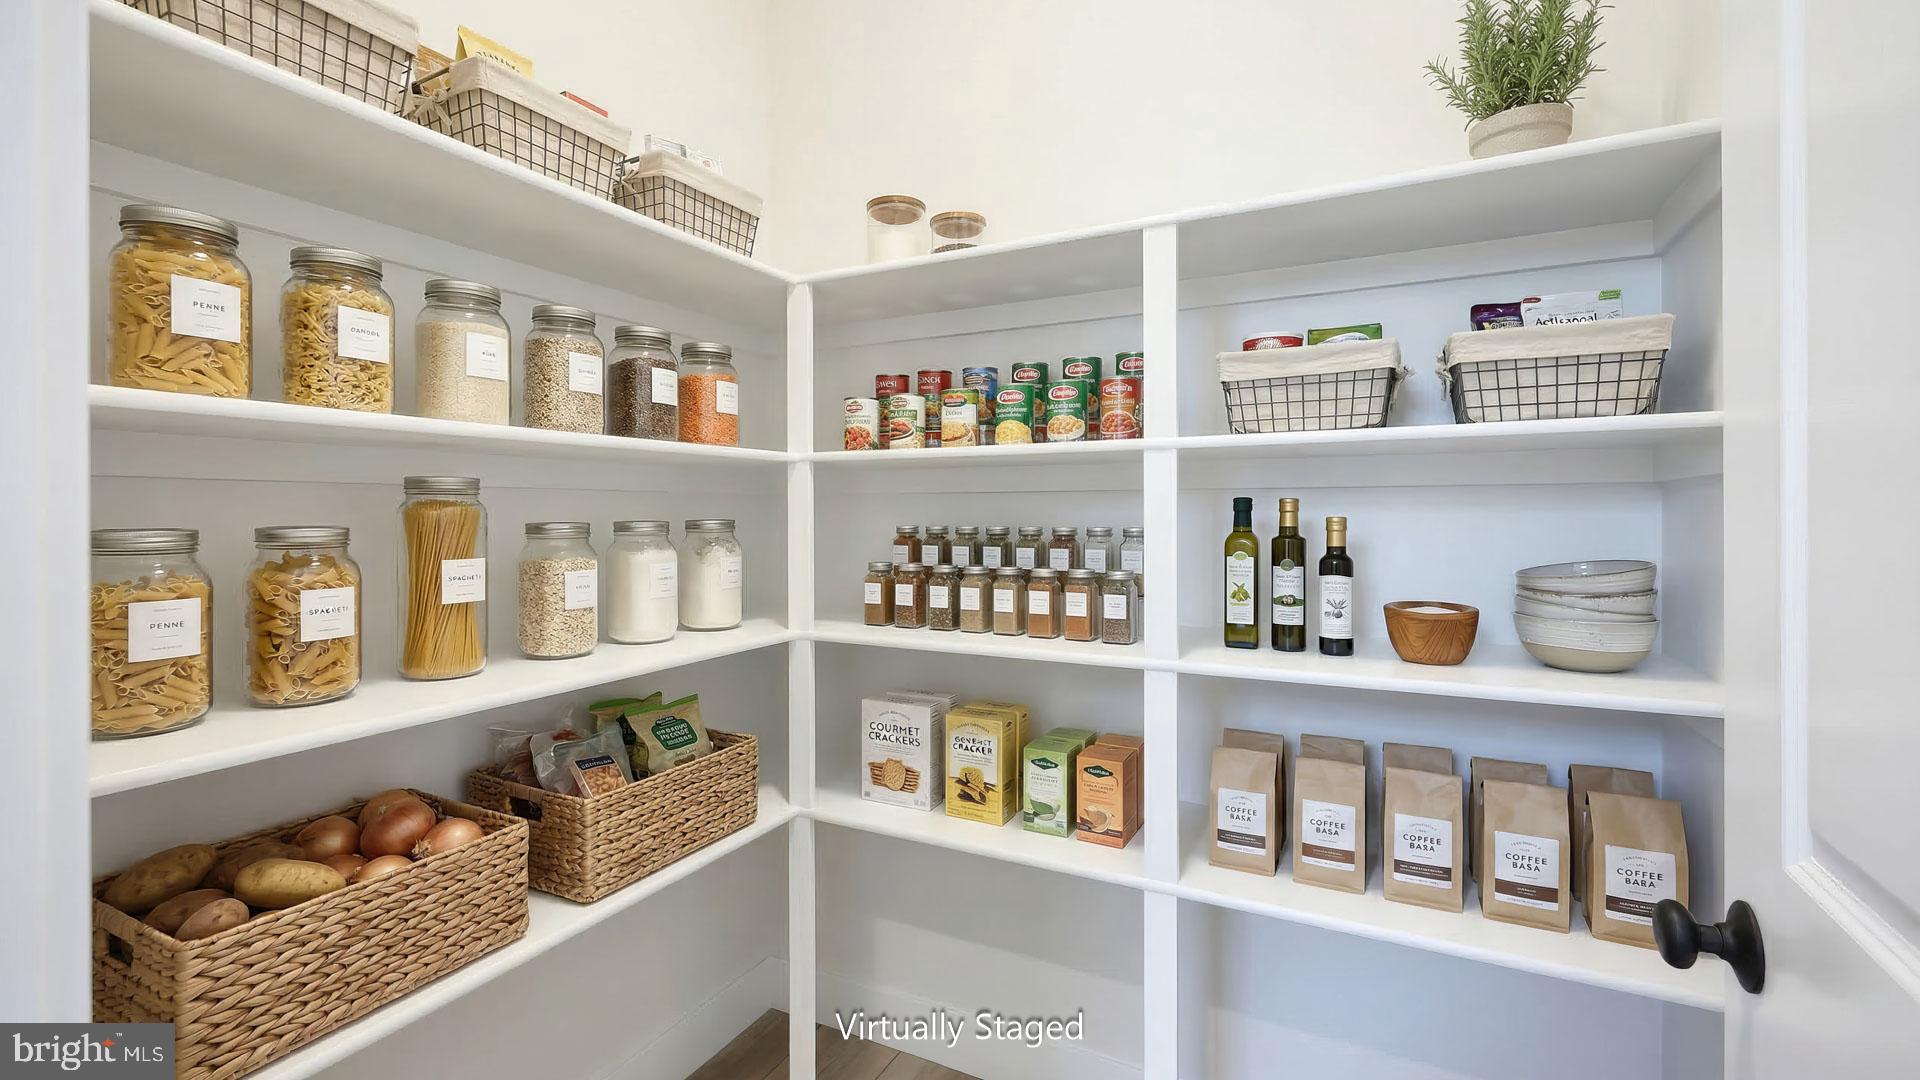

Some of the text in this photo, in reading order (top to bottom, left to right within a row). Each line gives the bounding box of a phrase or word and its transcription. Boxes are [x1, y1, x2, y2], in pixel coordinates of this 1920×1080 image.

[193, 300, 225, 312] PENNE
[149, 620, 185, 630] PENNE
[868, 731, 921, 747] CRACKERS
[1310, 818, 1346, 830] COFFEE
[1505, 852, 1548, 866] COFFEE
[1512, 861, 1541, 872] BASA
[1616, 867, 1664, 881] COFFEE
